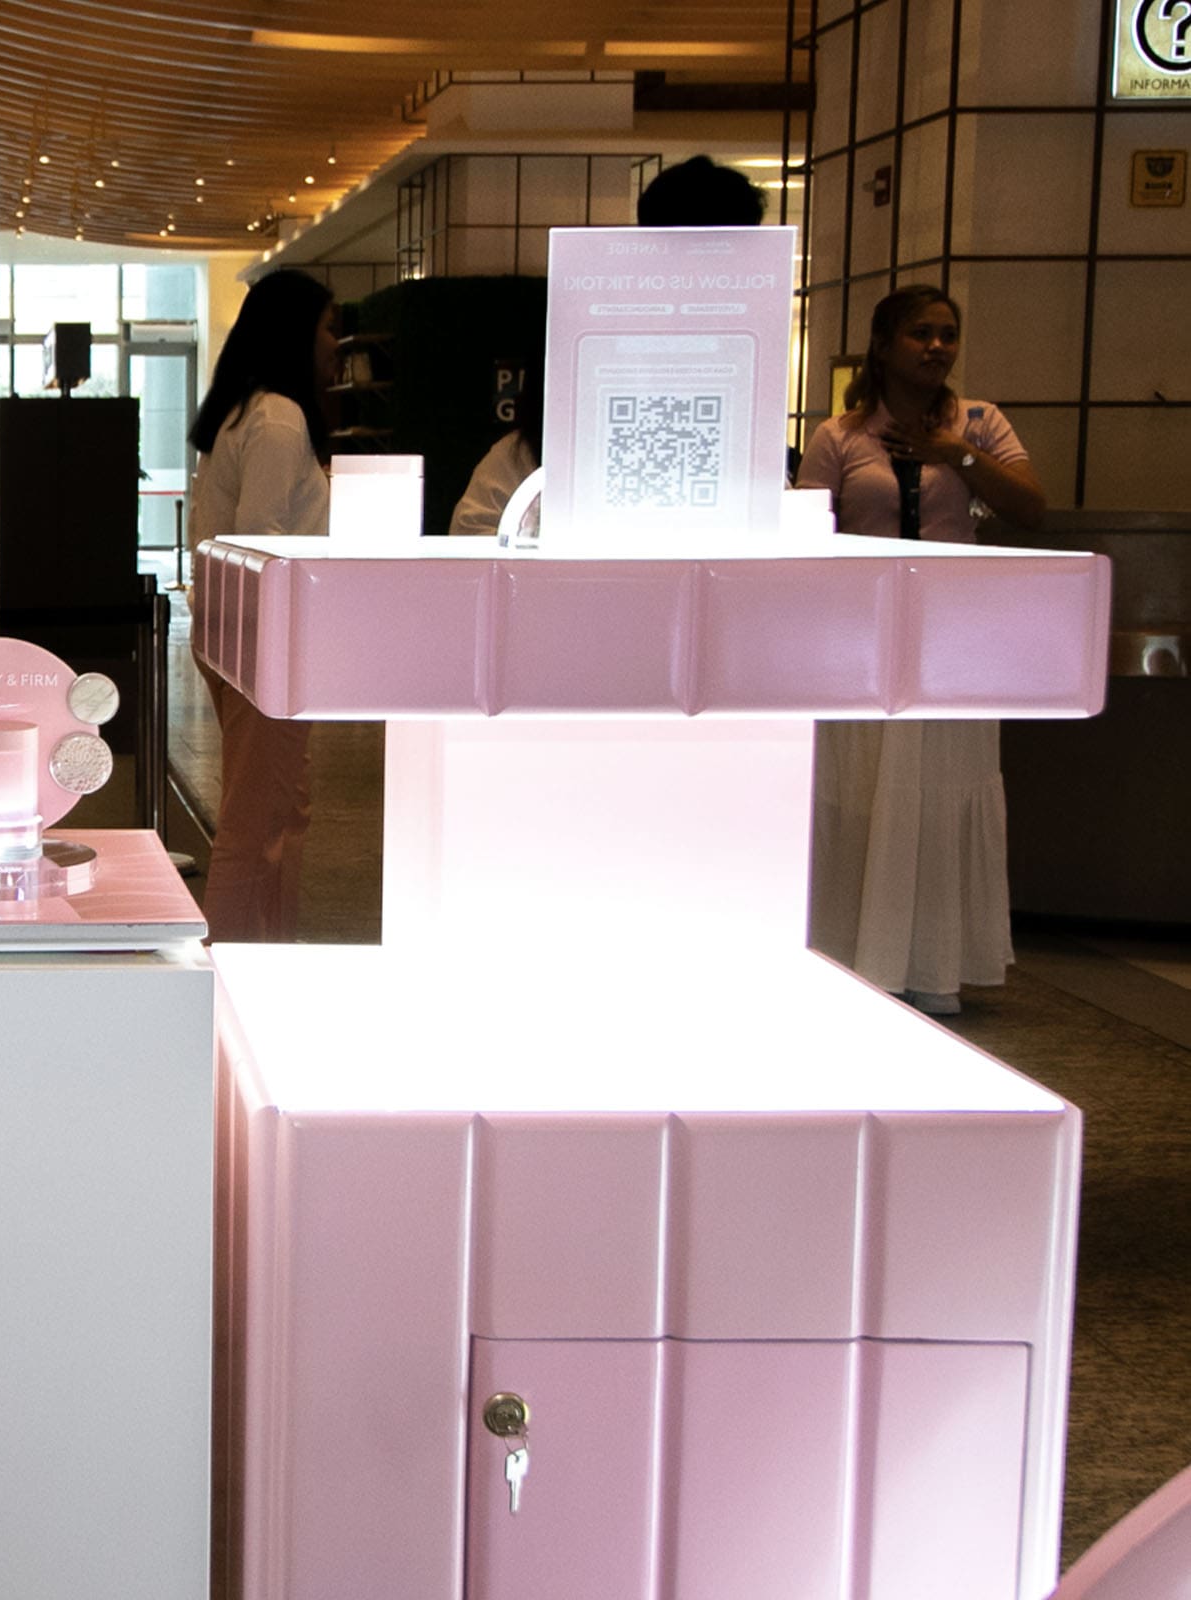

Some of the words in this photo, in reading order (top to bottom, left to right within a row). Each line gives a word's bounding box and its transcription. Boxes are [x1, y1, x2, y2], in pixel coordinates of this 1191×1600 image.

[1130, 78, 1191, 90] INFORMA
[7, 673, 17, 687] &
[20, 673, 58, 687] FIRM
